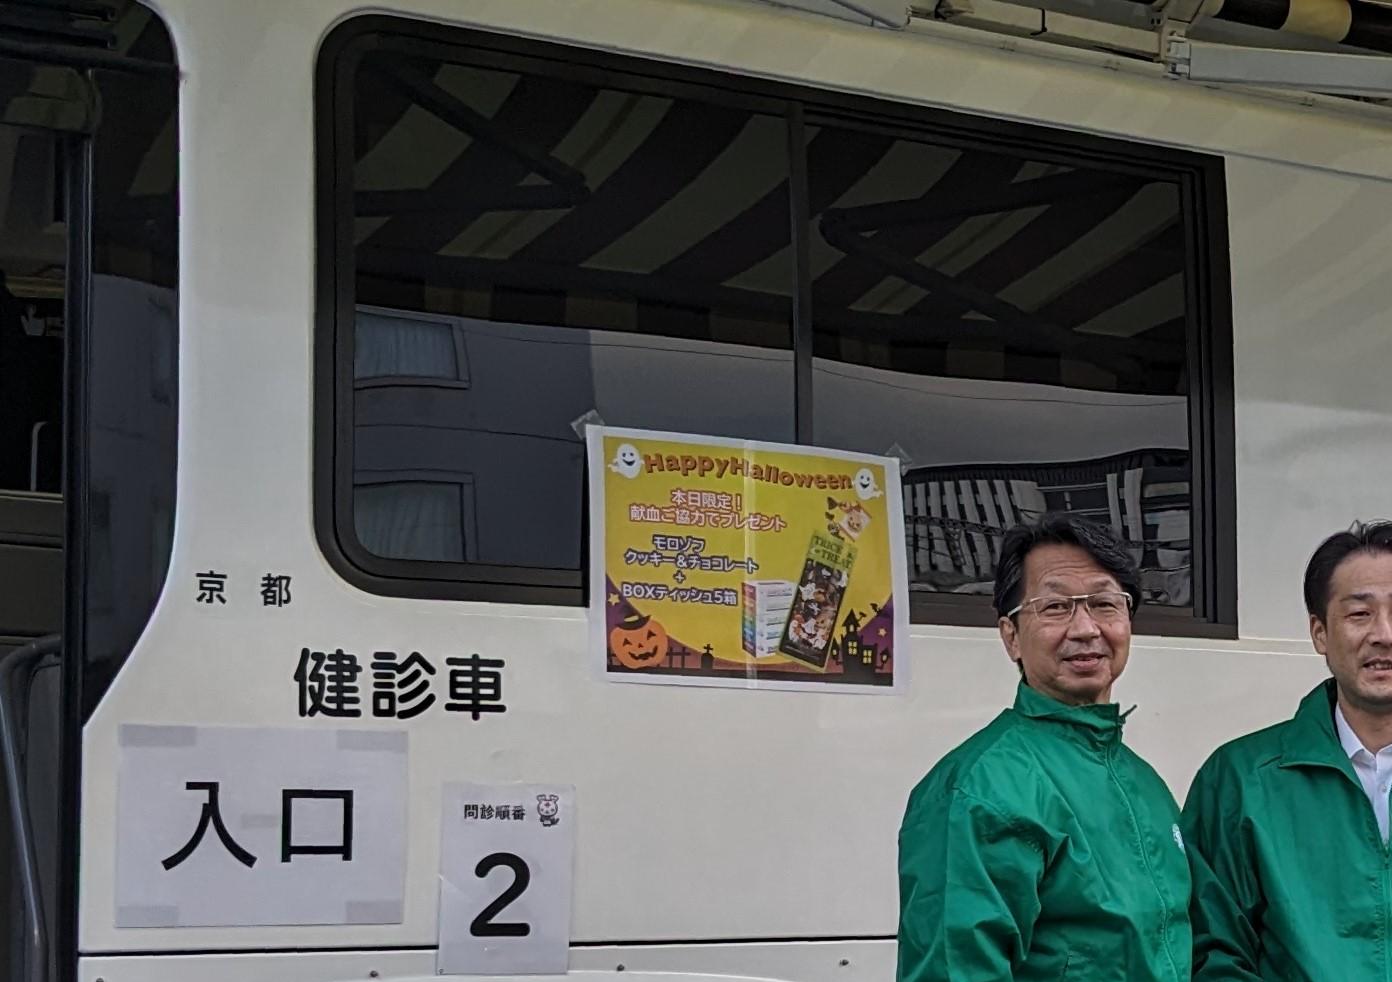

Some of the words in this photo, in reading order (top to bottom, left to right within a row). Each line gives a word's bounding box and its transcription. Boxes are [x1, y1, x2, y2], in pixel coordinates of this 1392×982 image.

[630, 505, 787, 532] 献血ご協力でプレゼント
[653, 535, 705, 552] モロゾフ
[621, 583, 737, 606] BOXティッシュ5箱
[294, 647, 507, 721] 健診車
[162, 781, 354, 871] 入口
[463, 804, 526, 821] 問診順番
[470, 853, 531, 937] 2
